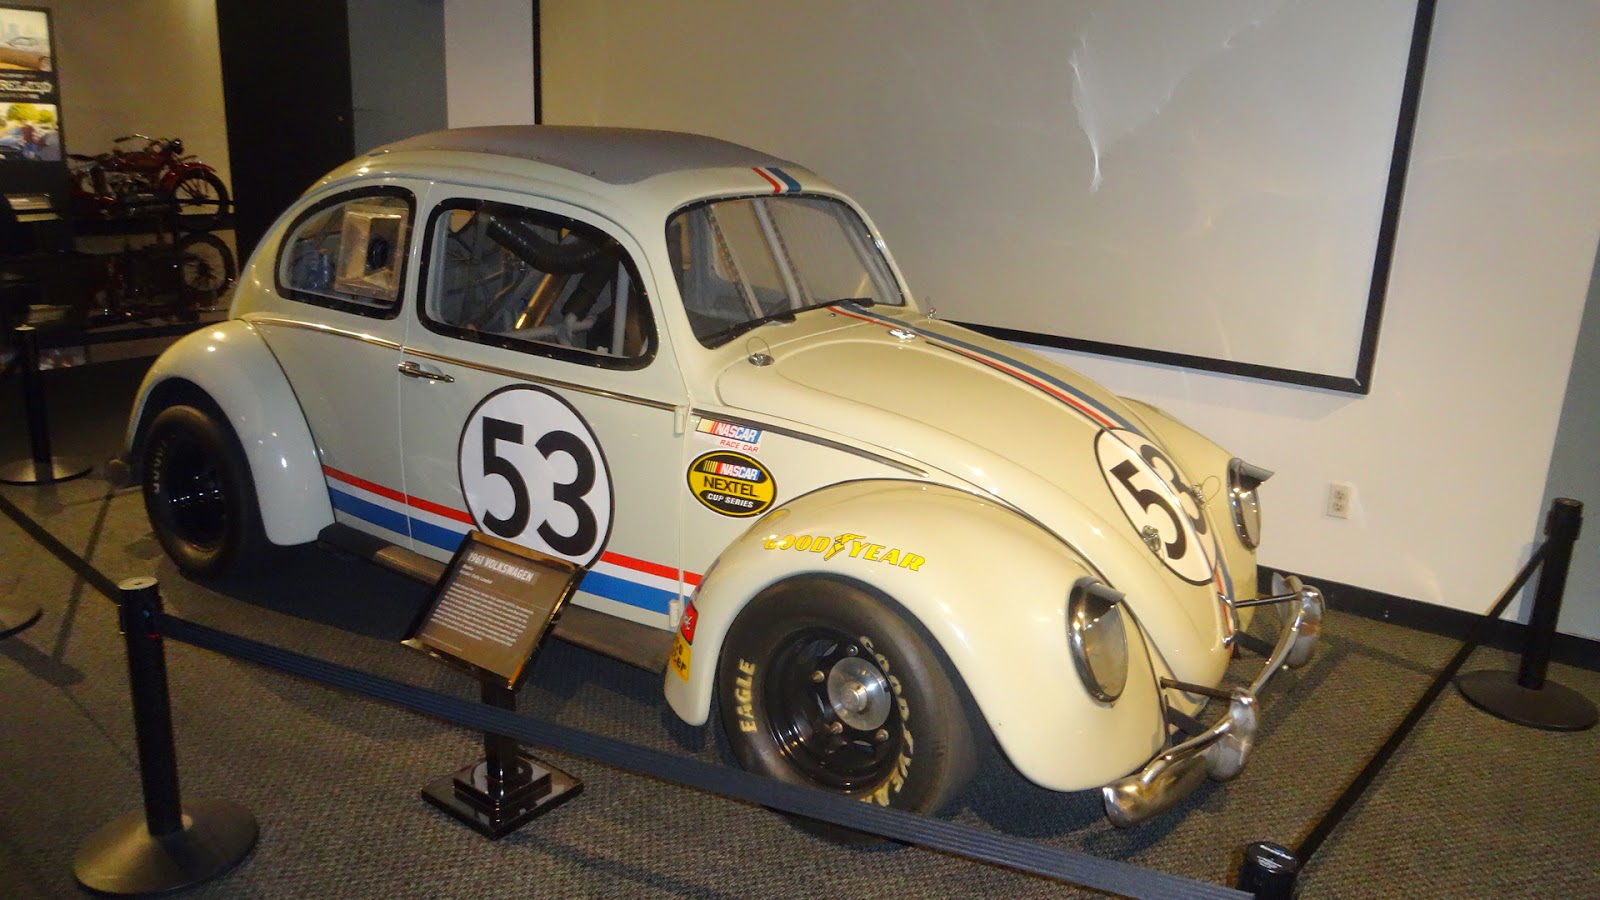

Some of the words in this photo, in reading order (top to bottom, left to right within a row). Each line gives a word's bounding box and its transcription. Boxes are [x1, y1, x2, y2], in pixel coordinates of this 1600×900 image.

[716, 421, 758, 442] NASCAR
[720, 439, 741, 449] RACE
[743, 444, 759, 452] CAR
[721, 461, 758, 480] NASCAR
[482, 416, 598, 557] 53
[704, 475, 759, 497] NEXTEL
[707, 492, 724, 502] CUP
[725, 496, 754, 508] SERIES
[1109, 444, 1207, 560] 53
[468, 552, 485, 564] 1961
[484, 558, 535, 582] VOLKSWAGEN
[735, 658, 757, 733] EAGLE
